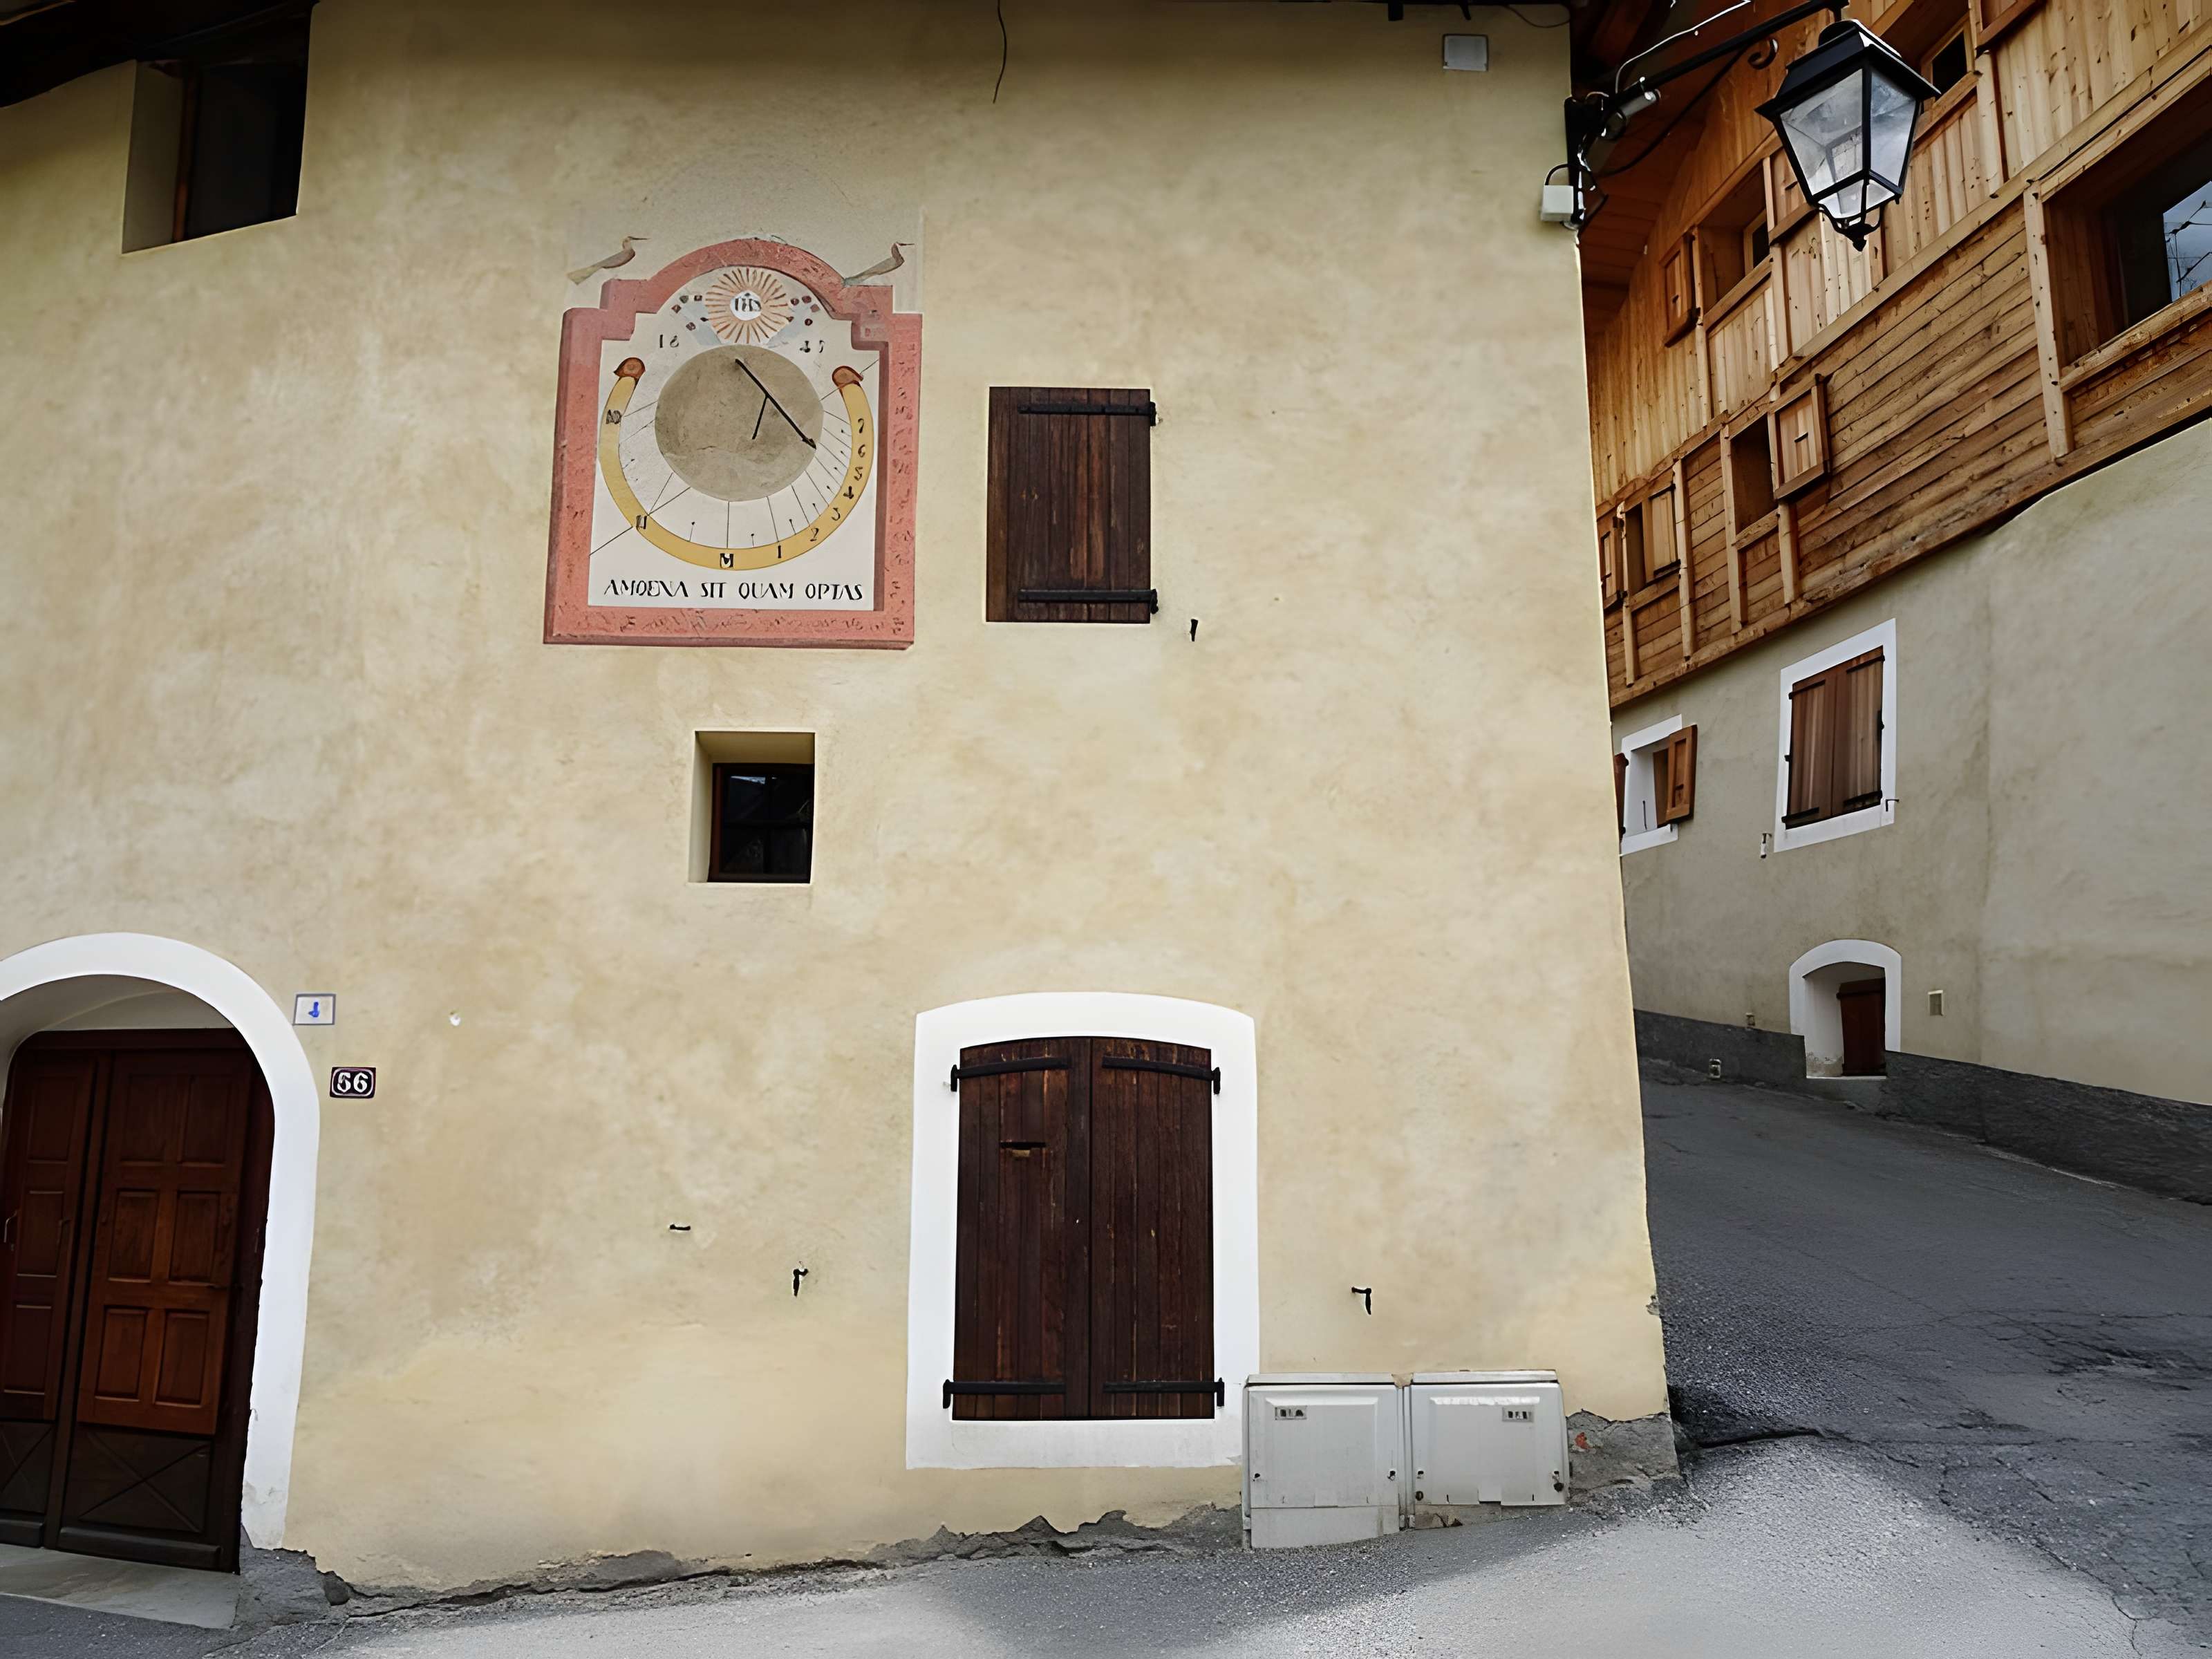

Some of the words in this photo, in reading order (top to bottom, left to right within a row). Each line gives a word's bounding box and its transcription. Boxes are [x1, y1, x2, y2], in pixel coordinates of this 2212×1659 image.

[858, 444, 866, 458] 6
[809, 527, 819, 542] 2
[701, 581, 727, 599] SIT
[738, 582, 794, 600] QUAM
[805, 583, 863, 601] OPTAS
